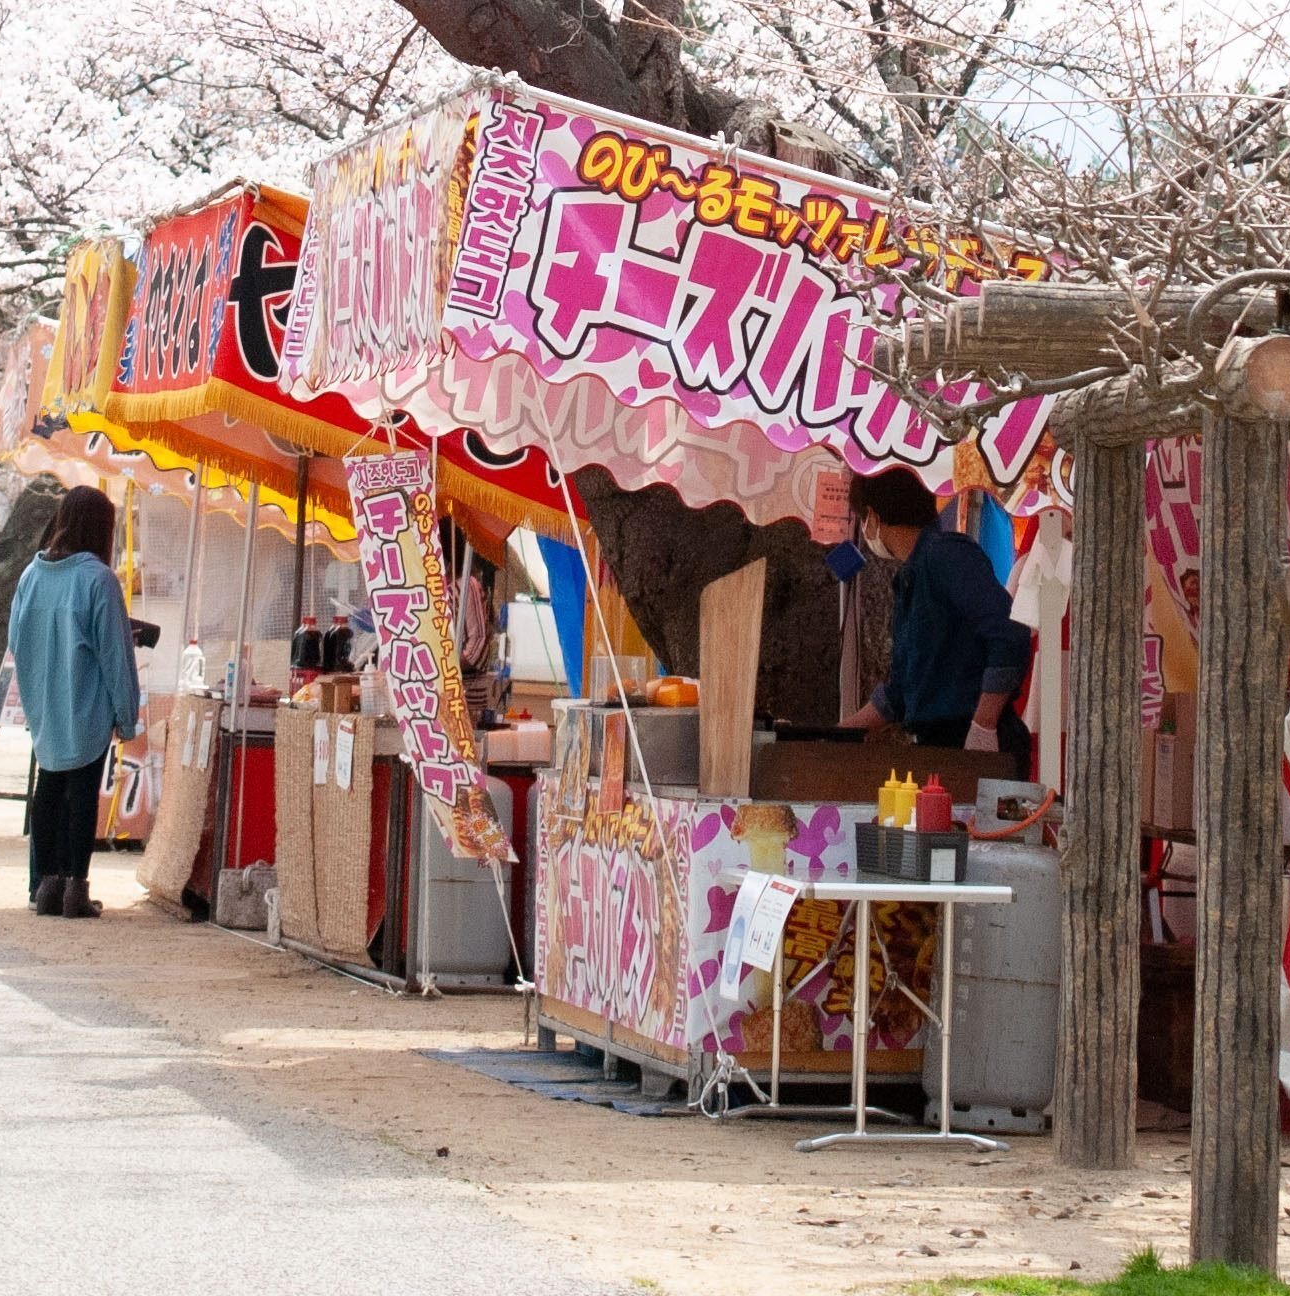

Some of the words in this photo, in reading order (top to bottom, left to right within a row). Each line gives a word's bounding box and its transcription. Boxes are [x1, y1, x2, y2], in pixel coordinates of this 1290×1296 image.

[361, 490, 471, 807] チーズハットグ
